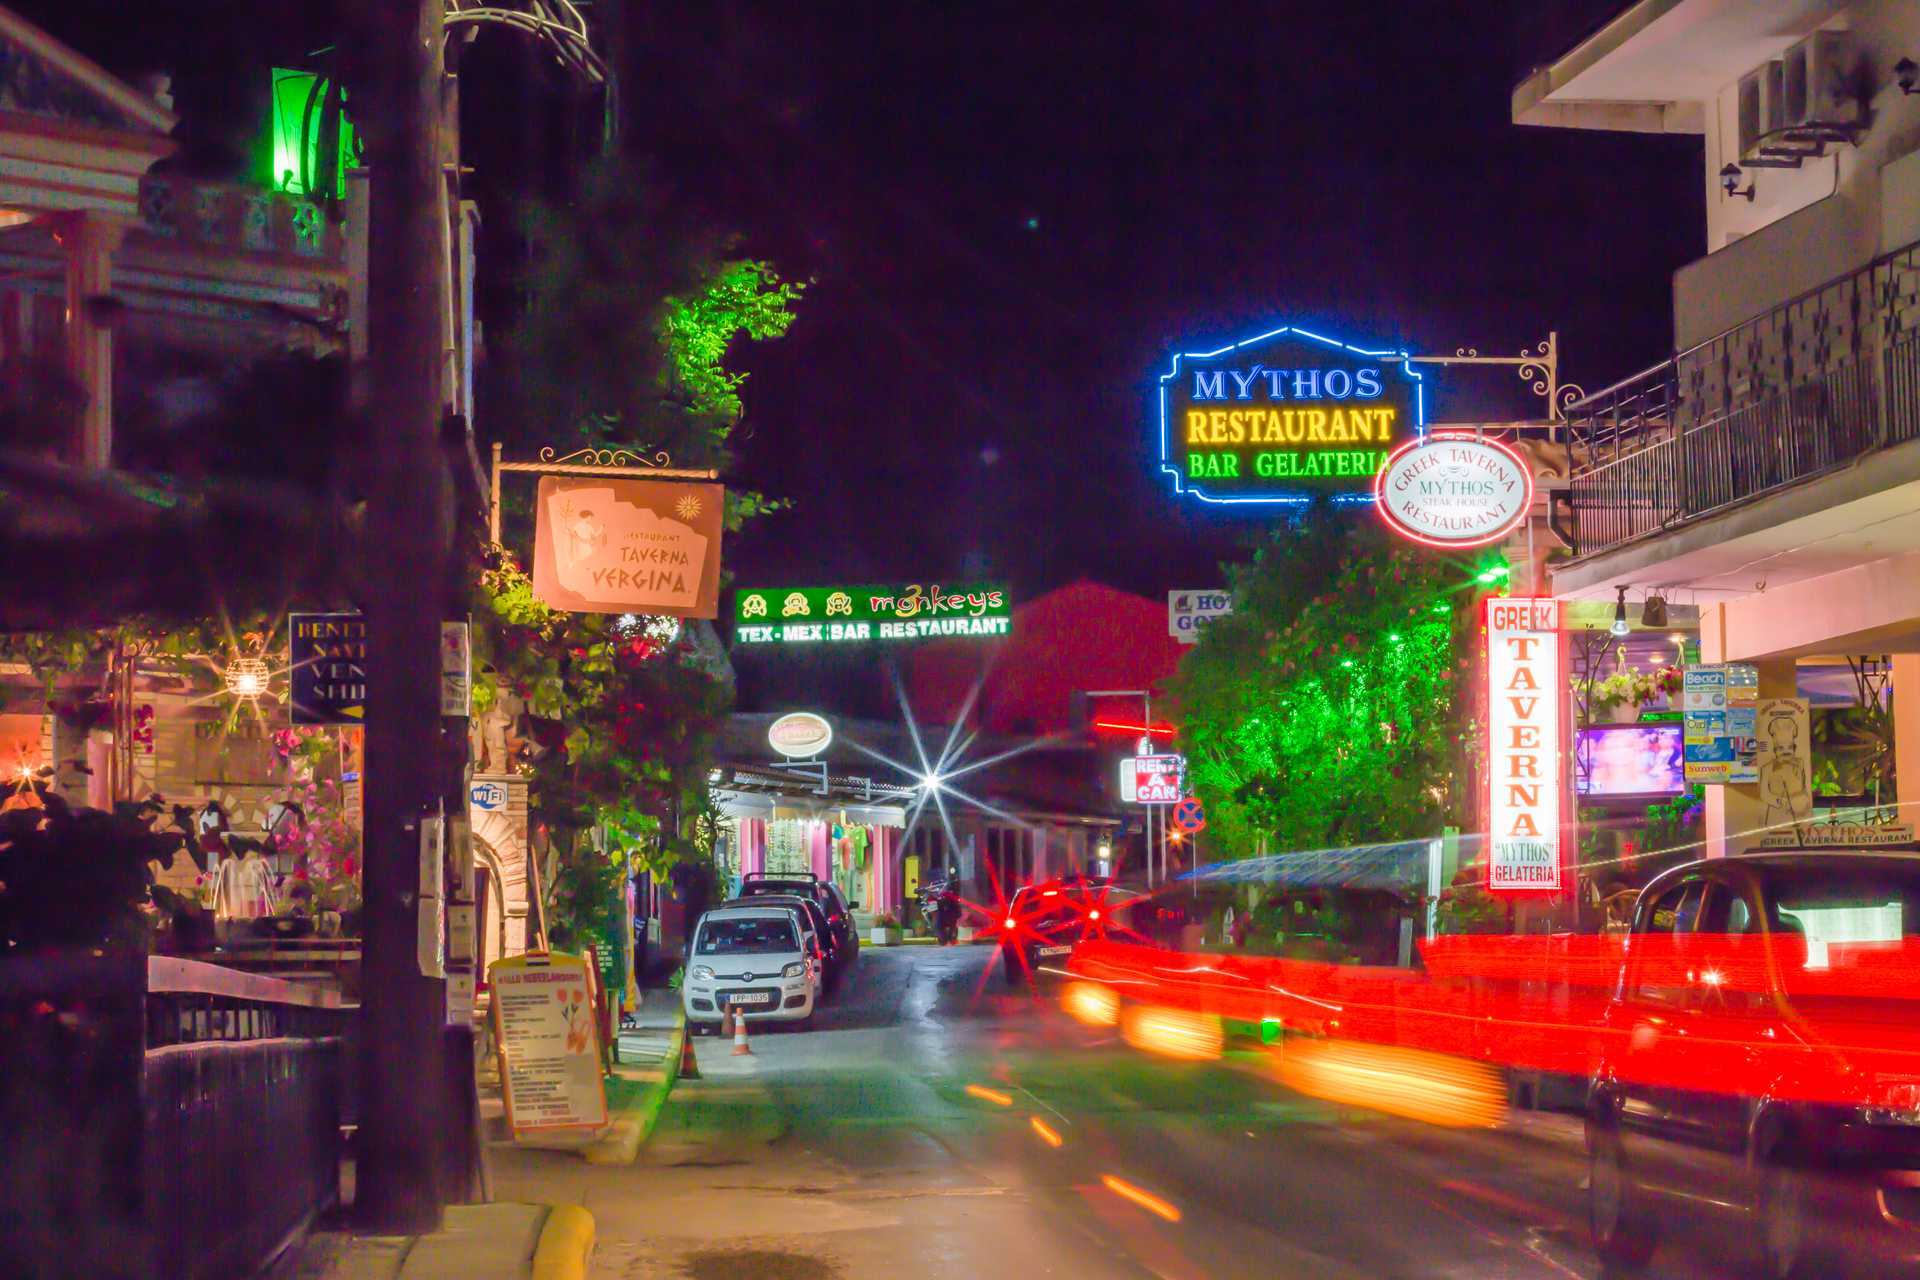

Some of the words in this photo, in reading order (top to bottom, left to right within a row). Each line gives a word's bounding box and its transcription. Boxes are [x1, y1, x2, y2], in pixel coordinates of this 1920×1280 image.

[1192, 363, 1383, 400] MYTHOS
[1186, 408, 1396, 443] RESTAURANT
[1189, 453, 1240, 478] BAR
[1256, 449, 1392, 477] GELATERIA
[1394, 451, 1441, 492] GREEK
[1449, 448, 1517, 494] TAVERNA
[1418, 478, 1496, 497] MYTHOS
[1422, 498, 1451, 508] STEAK
[1456, 498, 1489, 508] HOUSE
[1401, 501, 1508, 531] RESTAURANT
[621, 546, 689, 566] TAVERNA
[831, 622, 871, 640] BAR
[880, 617, 1010, 639] RESTAURANT
[1494, 606, 1552, 631] GREEK
[1686, 672, 1724, 685] Beach
[1504, 637, 1543, 837] TAVERNA
[1147, 773, 1166, 787] A
[1799, 834, 1845, 845] AVERNA
[1851, 833, 1913, 844] RESTAURANT
[1495, 866, 1554, 881] GELATERIA
